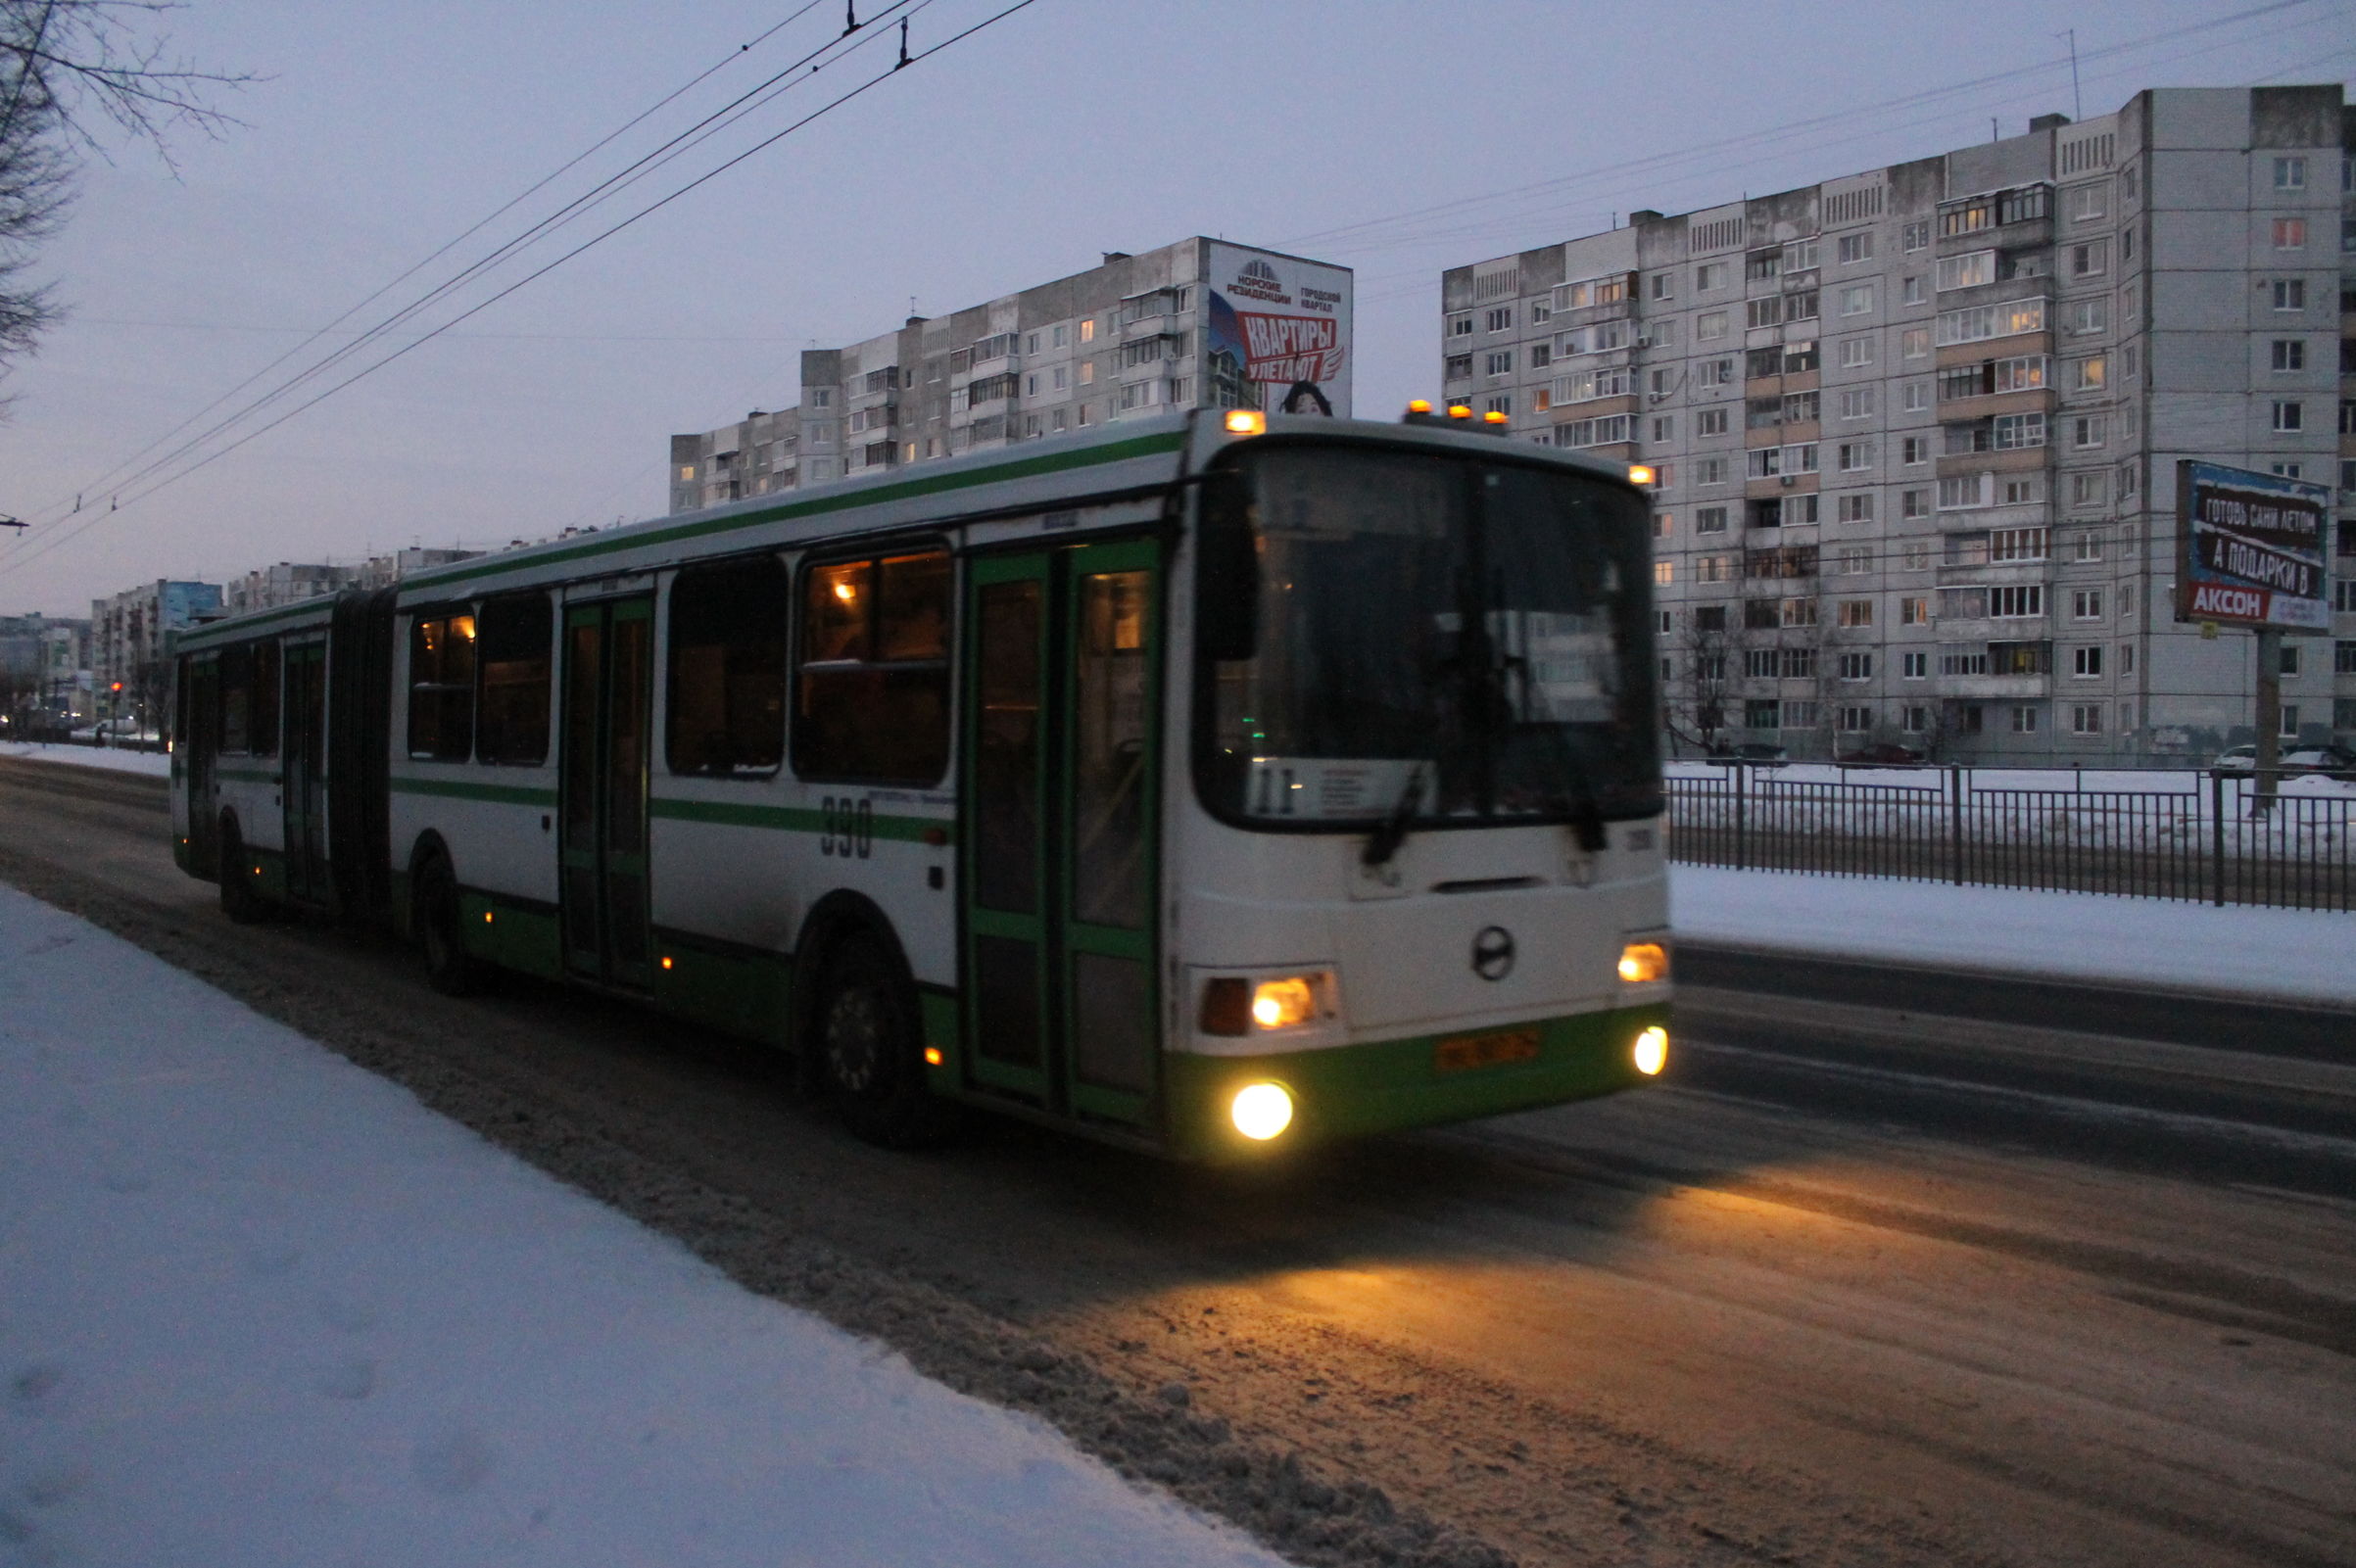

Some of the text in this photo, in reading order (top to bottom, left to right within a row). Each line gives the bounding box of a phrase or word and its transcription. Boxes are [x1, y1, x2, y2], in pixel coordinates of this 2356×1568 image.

[1227, 284, 1291, 306] РЕЗИДЕНЦИИ
[1238, 275, 1281, 293] НОРСКИЕ
[1301, 287, 1341, 304] ГОРОДСКОЙ
[1301, 300, 1332, 312] КВАРТАЛ
[1245, 316, 1332, 358] КВАРТИРЫ
[1249, 356, 1319, 380] УЛЕТАЮТ
[2206, 499, 2316, 535] ГОТОВЬ САНИ ЛЕТОМ
[2213, 539, 2309, 595] А ПОДАРКИ В
[2193, 587, 2261, 617] АКСОН
